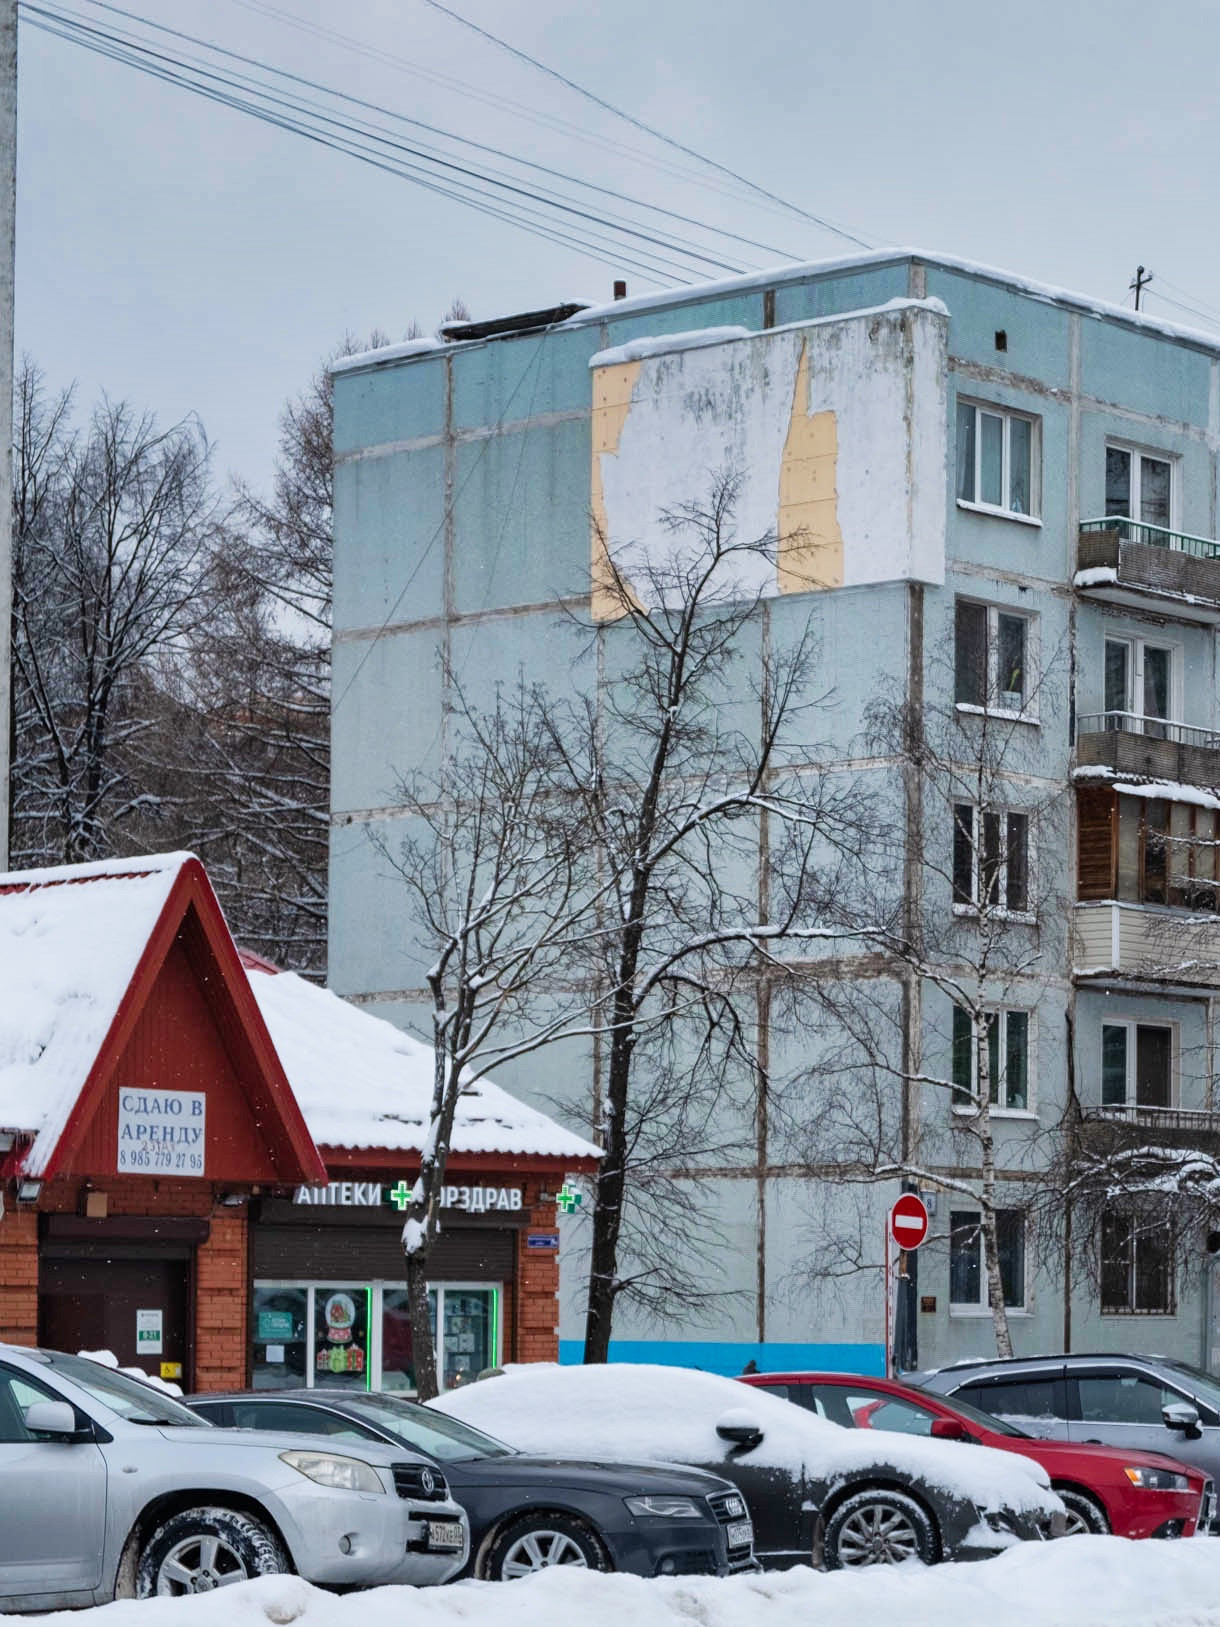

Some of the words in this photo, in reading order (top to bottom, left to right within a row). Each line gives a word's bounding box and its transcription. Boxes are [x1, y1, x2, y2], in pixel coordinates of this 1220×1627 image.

[122, 1095, 182, 1116] СДАЮ
[191, 1100, 202, 1116] В
[121, 1123, 202, 1144] АРЕНДУ
[120, 1150, 127, 1165] 8
[130, 1150, 150, 1167] 985
[155, 1151, 172, 1168] 779
[175, 1153, 186, 1169] 27
[190, 1153, 202, 1170] 95
[294, 1182, 381, 1206] АПТЕКИ
